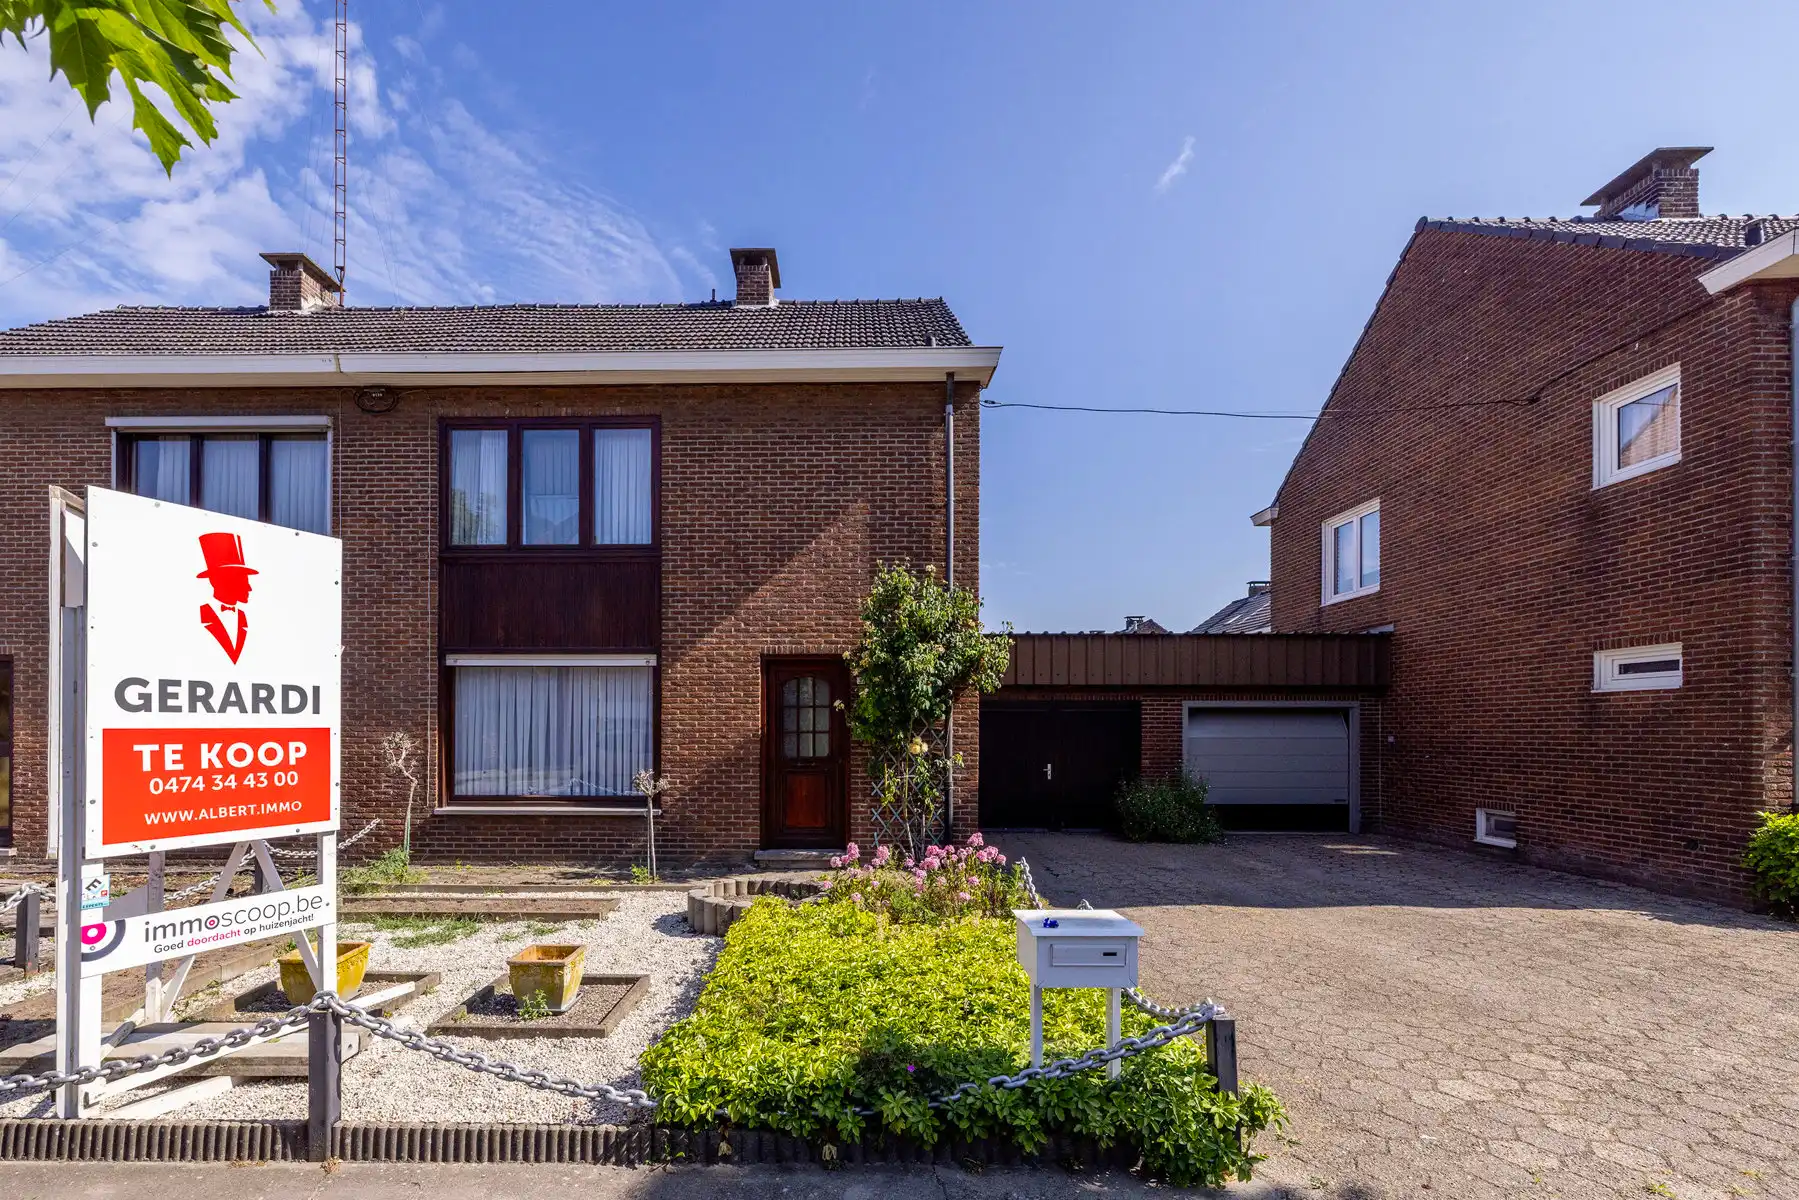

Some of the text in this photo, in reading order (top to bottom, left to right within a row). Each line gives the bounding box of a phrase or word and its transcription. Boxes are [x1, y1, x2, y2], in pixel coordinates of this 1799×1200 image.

[114, 676, 321, 715] GERARDI
[133, 741, 307, 772] TE KOOP
[149, 770, 299, 795] 0474 34 43 00
[144, 800, 302, 825] WWW.ALBERT.IMMO
[144, 894, 323, 943] immoscoop.be
[154, 913, 314, 954] Goed doordacht op huizenjacht!
